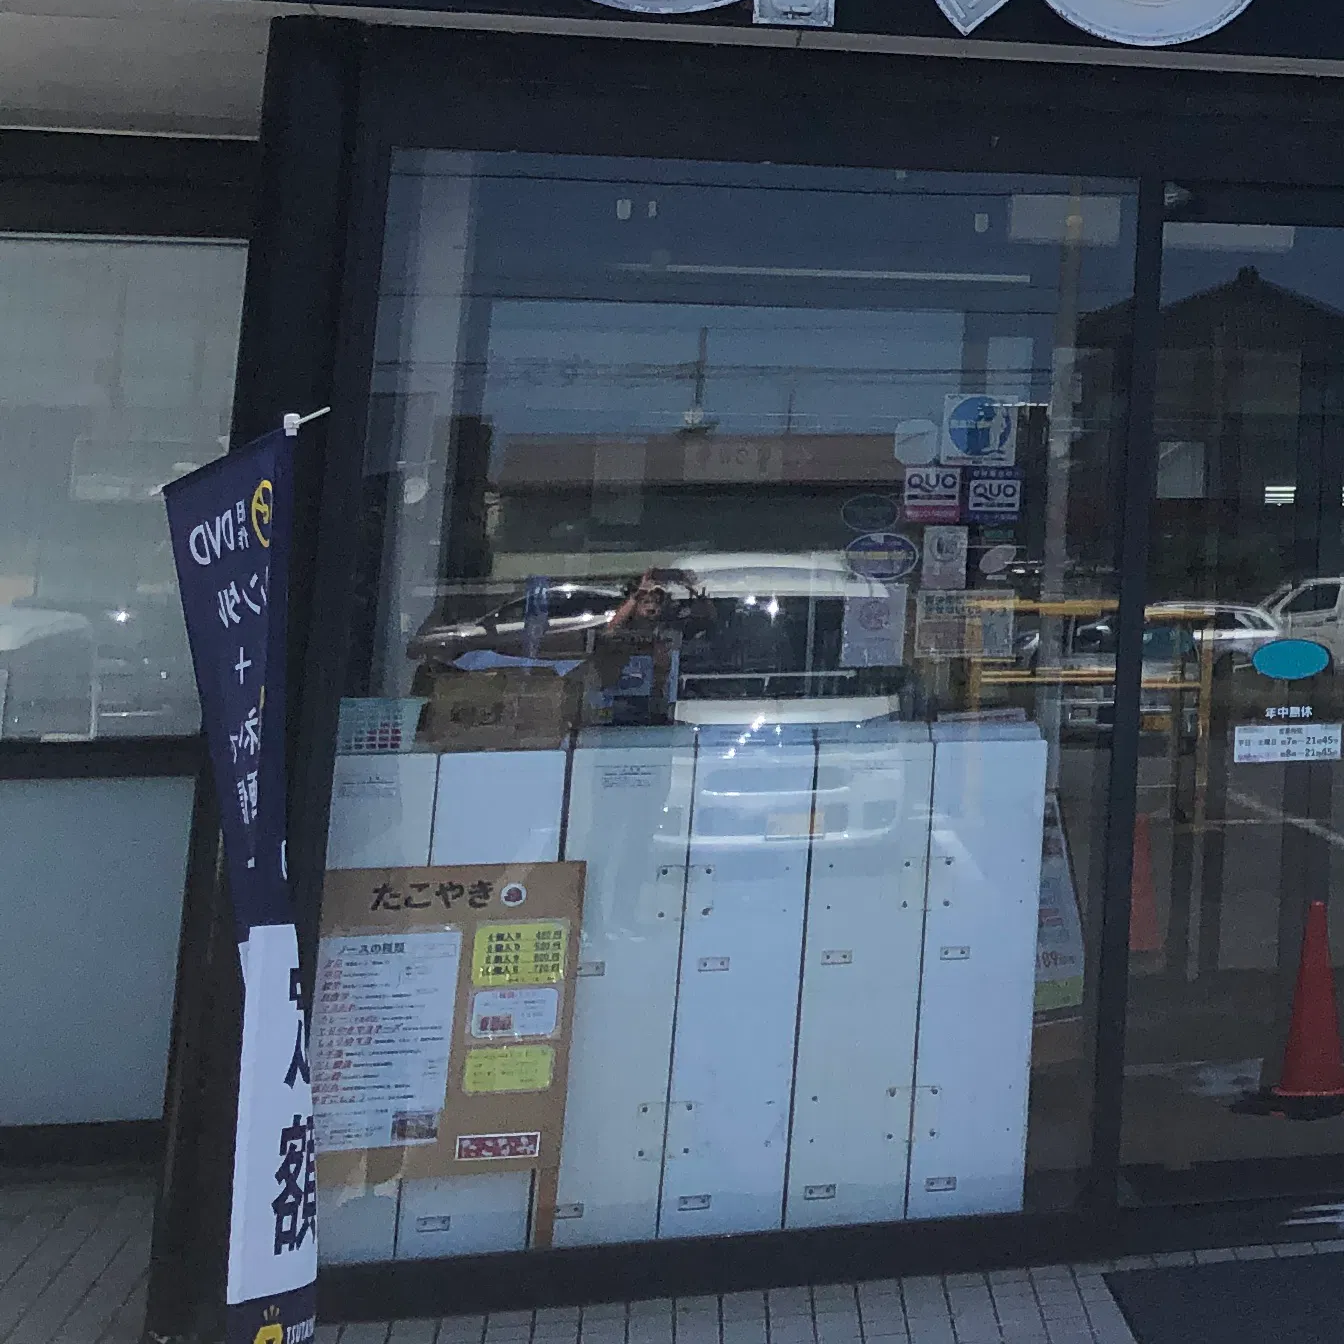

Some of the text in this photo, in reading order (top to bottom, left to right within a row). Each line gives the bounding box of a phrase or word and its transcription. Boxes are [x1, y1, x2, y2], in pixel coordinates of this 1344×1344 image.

[907, 472, 958, 493] QUO
[973, 483, 1017, 502] QUO
[370, 880, 496, 912] たこやき
